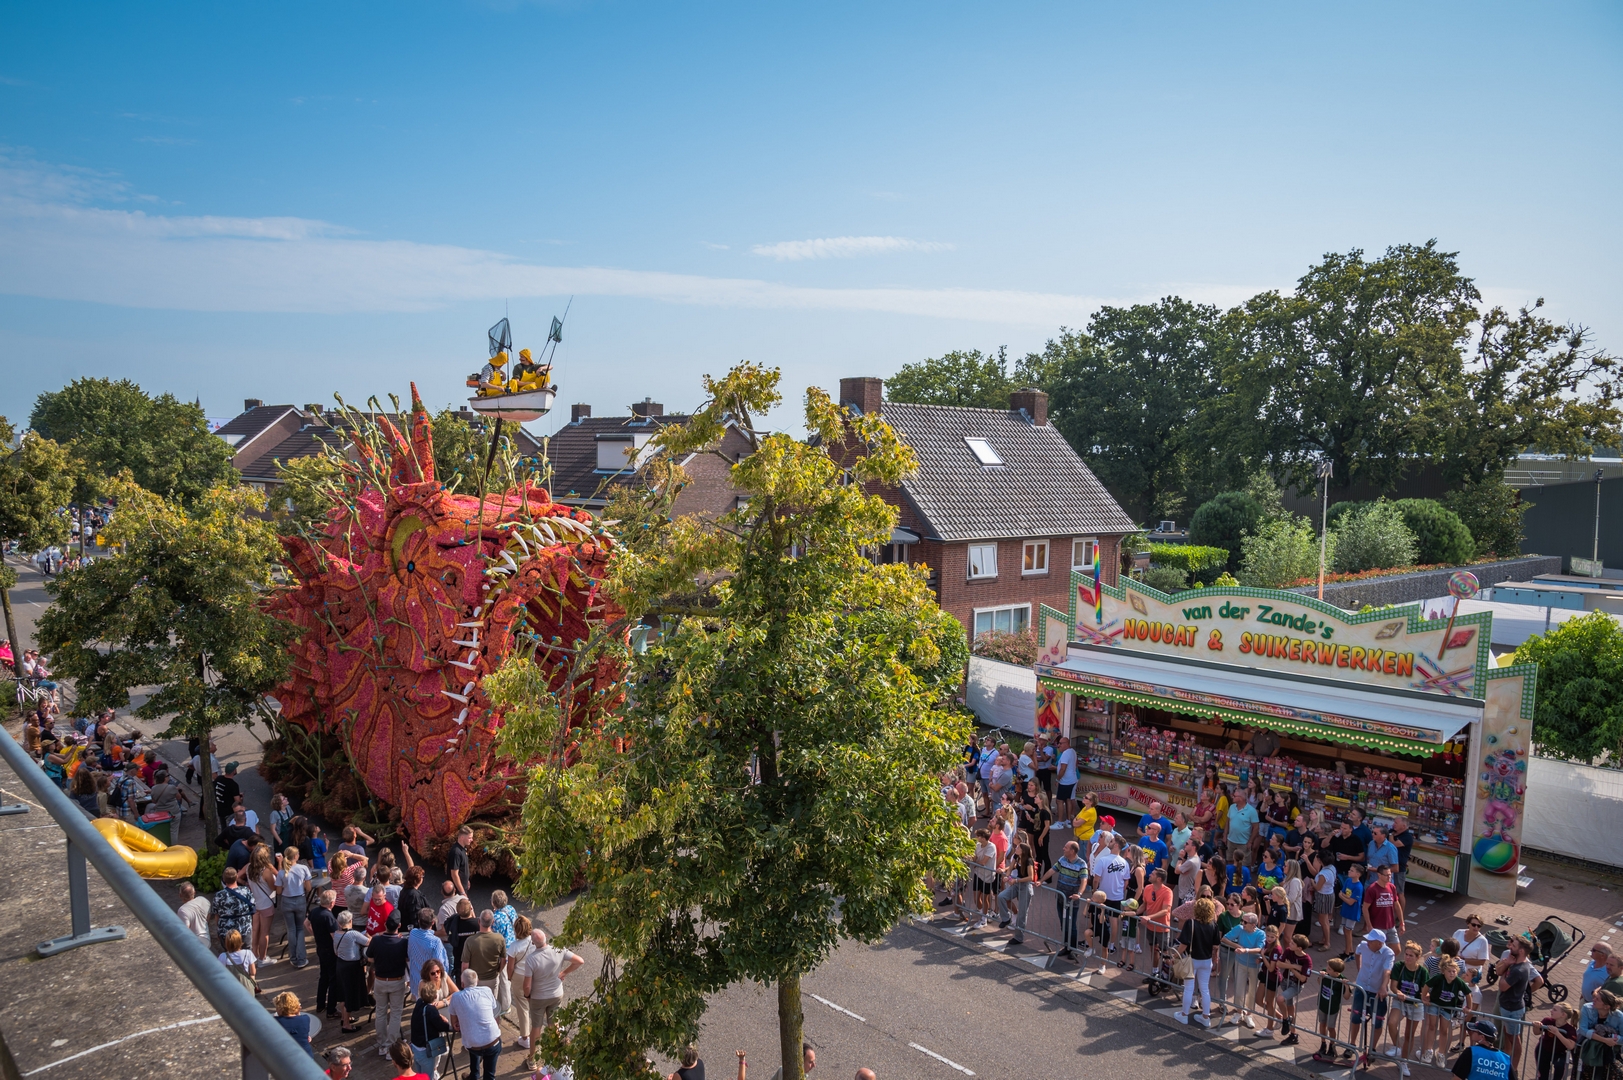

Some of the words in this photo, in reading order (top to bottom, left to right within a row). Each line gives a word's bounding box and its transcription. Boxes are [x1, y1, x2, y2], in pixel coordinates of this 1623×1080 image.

[1182, 605, 1213, 620] van
[1218, 601, 1250, 620] der
[1256, 604, 1334, 639] Zande's
[1123, 618, 1198, 647] NOUGAT
[1207, 628, 1223, 651] &
[1239, 631, 1414, 677] SUIKERWERKEN
[1080, 674, 1096, 683] VAN
[1321, 714, 1364, 730] BERGEN
[1366, 721, 1381, 732] OP
[1384, 724, 1418, 738] ZOOM
[1128, 786, 1176, 818] WIJNSTOKEN
[1408, 854, 1452, 878] STOKKEN
[1476, 1066, 1505, 1079] zundert
[1477, 1057, 1506, 1071] corso
